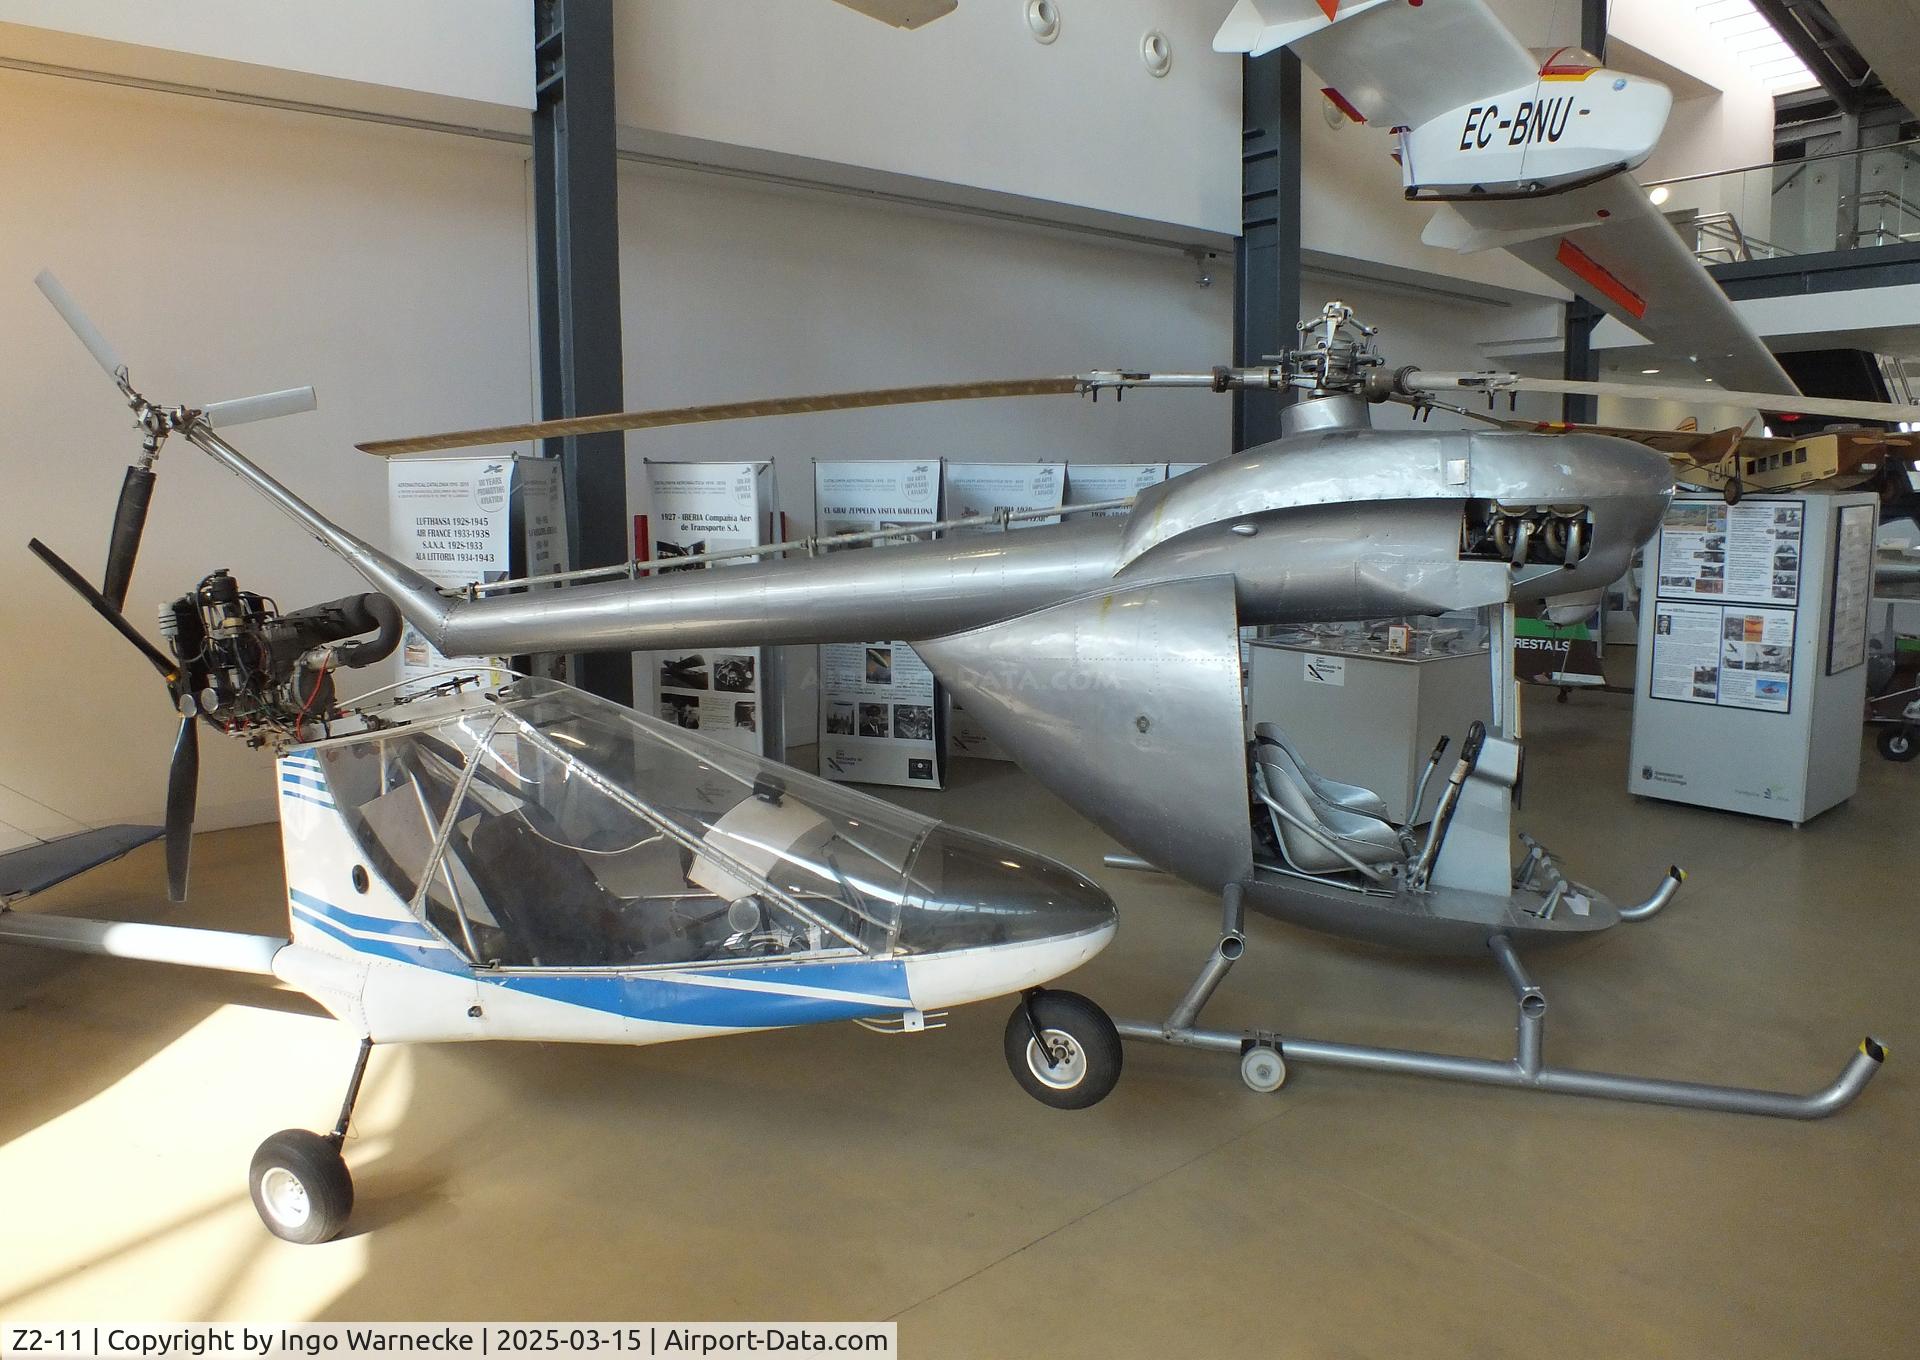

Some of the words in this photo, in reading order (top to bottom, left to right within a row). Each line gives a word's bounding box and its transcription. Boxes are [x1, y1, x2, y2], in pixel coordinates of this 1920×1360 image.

[1459, 96, 1574, 151] EC-BNU
[898, 507, 933, 515] BARCELONA
[416, 517, 451, 526] LUFTHANSA
[452, 517, 489, 527] 1928-1945
[661, 513, 676, 521] 1927
[682, 513, 703, 521] IBERIA
[690, 523, 725, 532] Transporte
[417, 529, 427, 538] AIR
[427, 529, 452, 538] FRANCE
[453, 529, 491, 539] 1933-1938
[448, 541, 484, 551] 1928-1933
[427, 552, 456, 561] LITTORIA
[457, 553, 495, 563] 1934-1943
